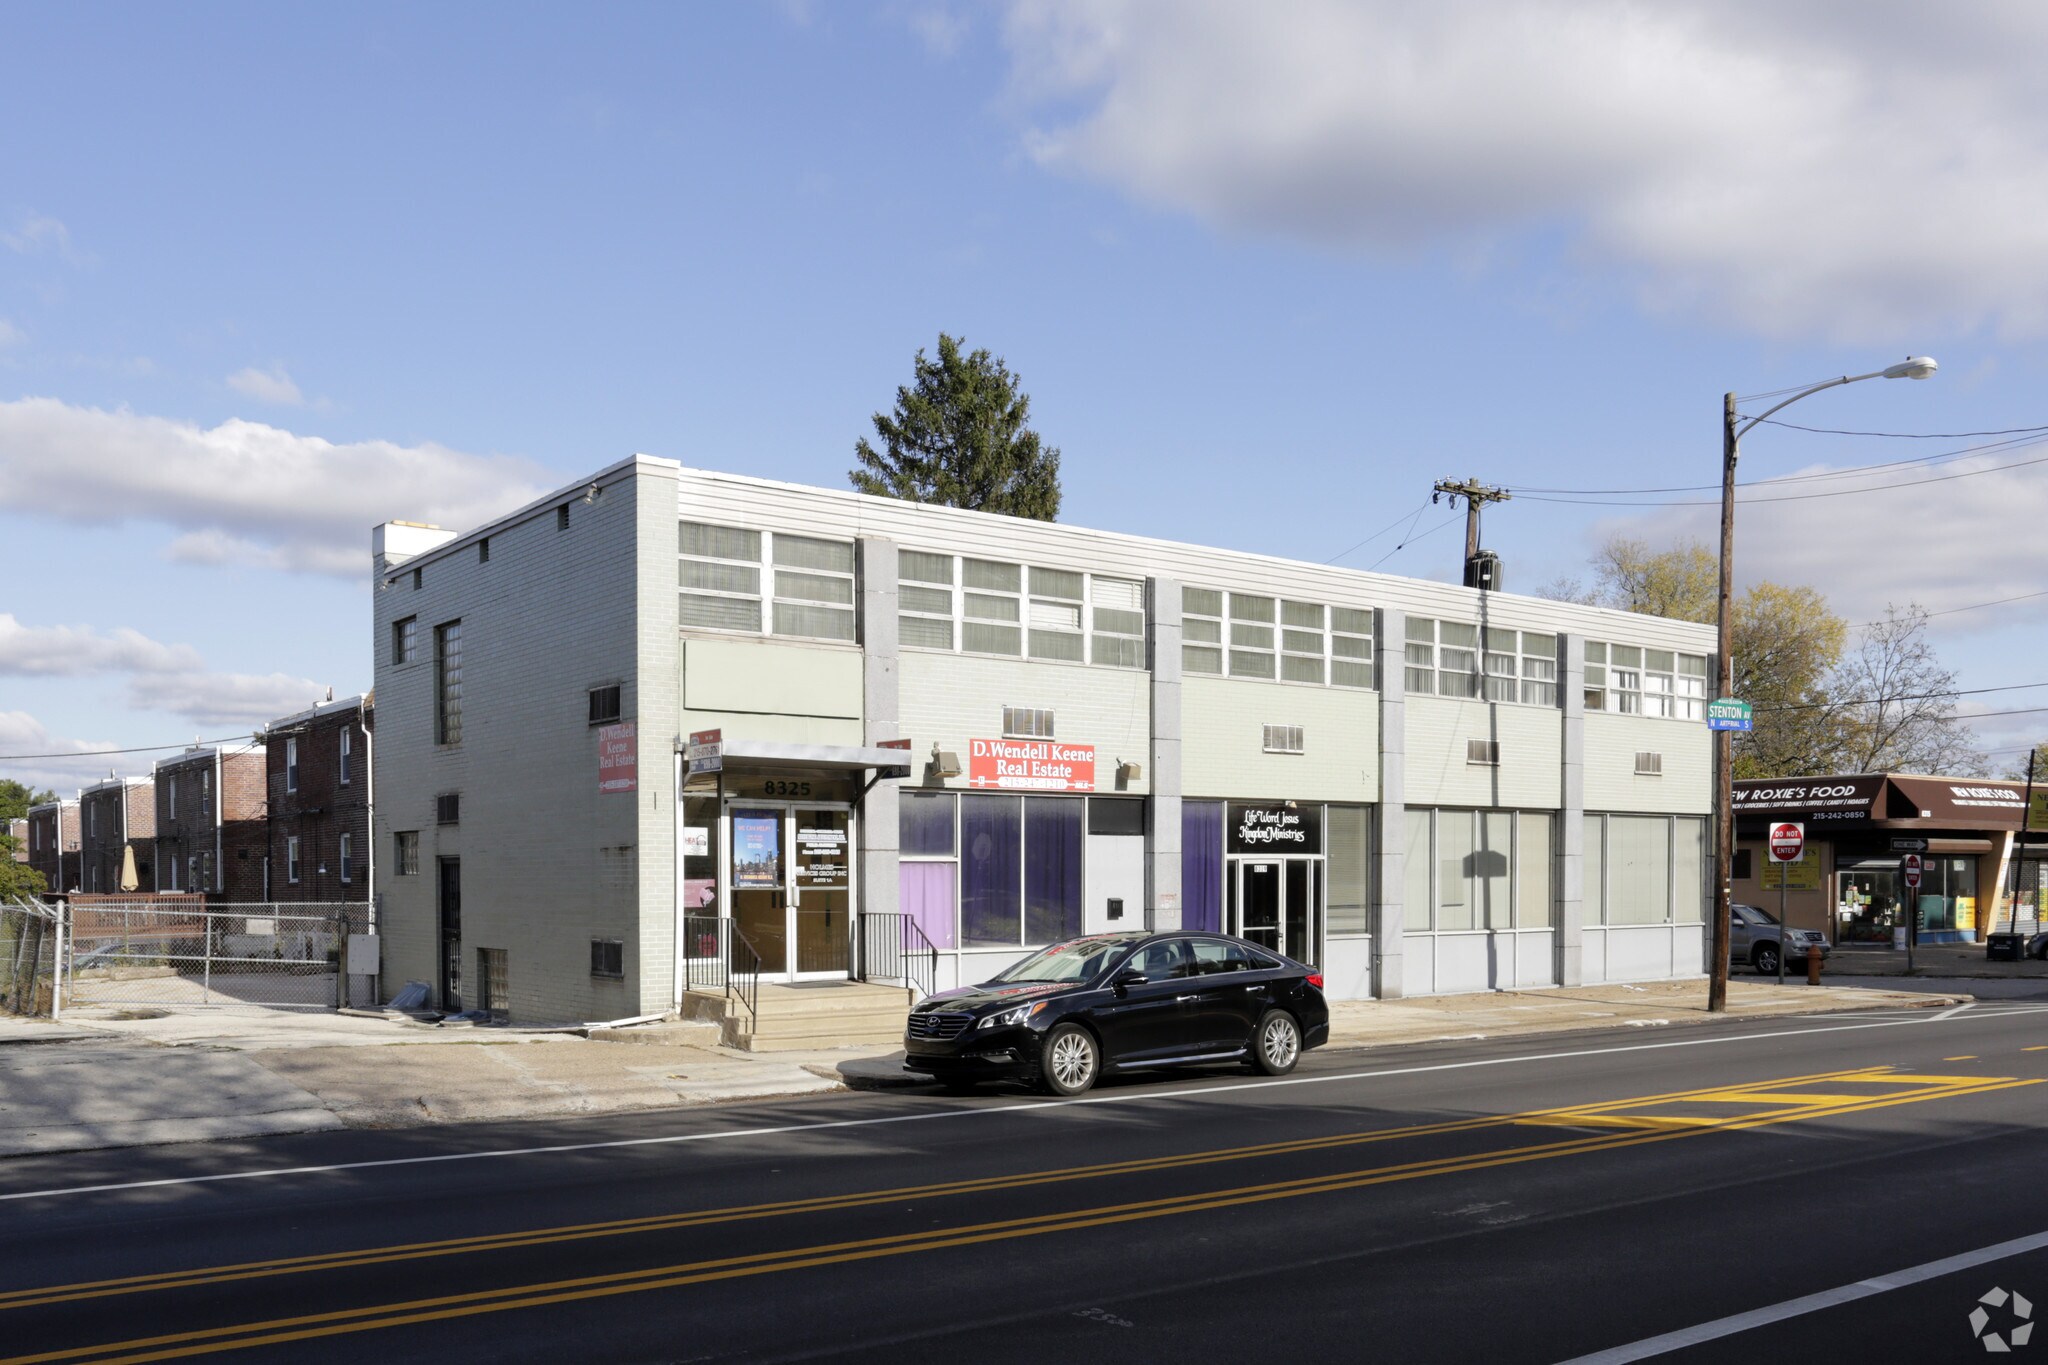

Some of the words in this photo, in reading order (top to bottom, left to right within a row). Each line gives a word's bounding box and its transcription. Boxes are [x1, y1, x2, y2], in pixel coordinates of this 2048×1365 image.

[1709, 705, 1742, 719] STENTON
[1743, 711, 1751, 719] AV
[1710, 718, 1716, 727] N
[1744, 720, 1749, 729] S
[607, 742, 628, 754] Keene
[973, 740, 1048, 760] D.Wendell
[1052, 745, 1094, 762] Keene
[600, 756, 614, 769] Real
[615, 754, 635, 767] Estate
[996, 759, 1028, 775] Real
[1032, 761, 1072, 778] Estate
[764, 781, 811, 796] 8325
[1732, 790, 1749, 801] EW
[1751, 787, 1806, 800] ROXIE'S
[1809, 785, 1856, 798] FOOD
[2037, 793, 2048, 801] NE
[1244, 810, 1257, 827] Life
[1256, 810, 1280, 824] Word
[1276, 811, 1300, 828] Jesus
[1812, 812, 1865, 820] 215-242-0850
[1239, 825, 1269, 844] Kingdom
[1262, 826, 1305, 843] Ministries
[1775, 830, 1784, 838] DO
[1786, 830, 1799, 838] NOT
